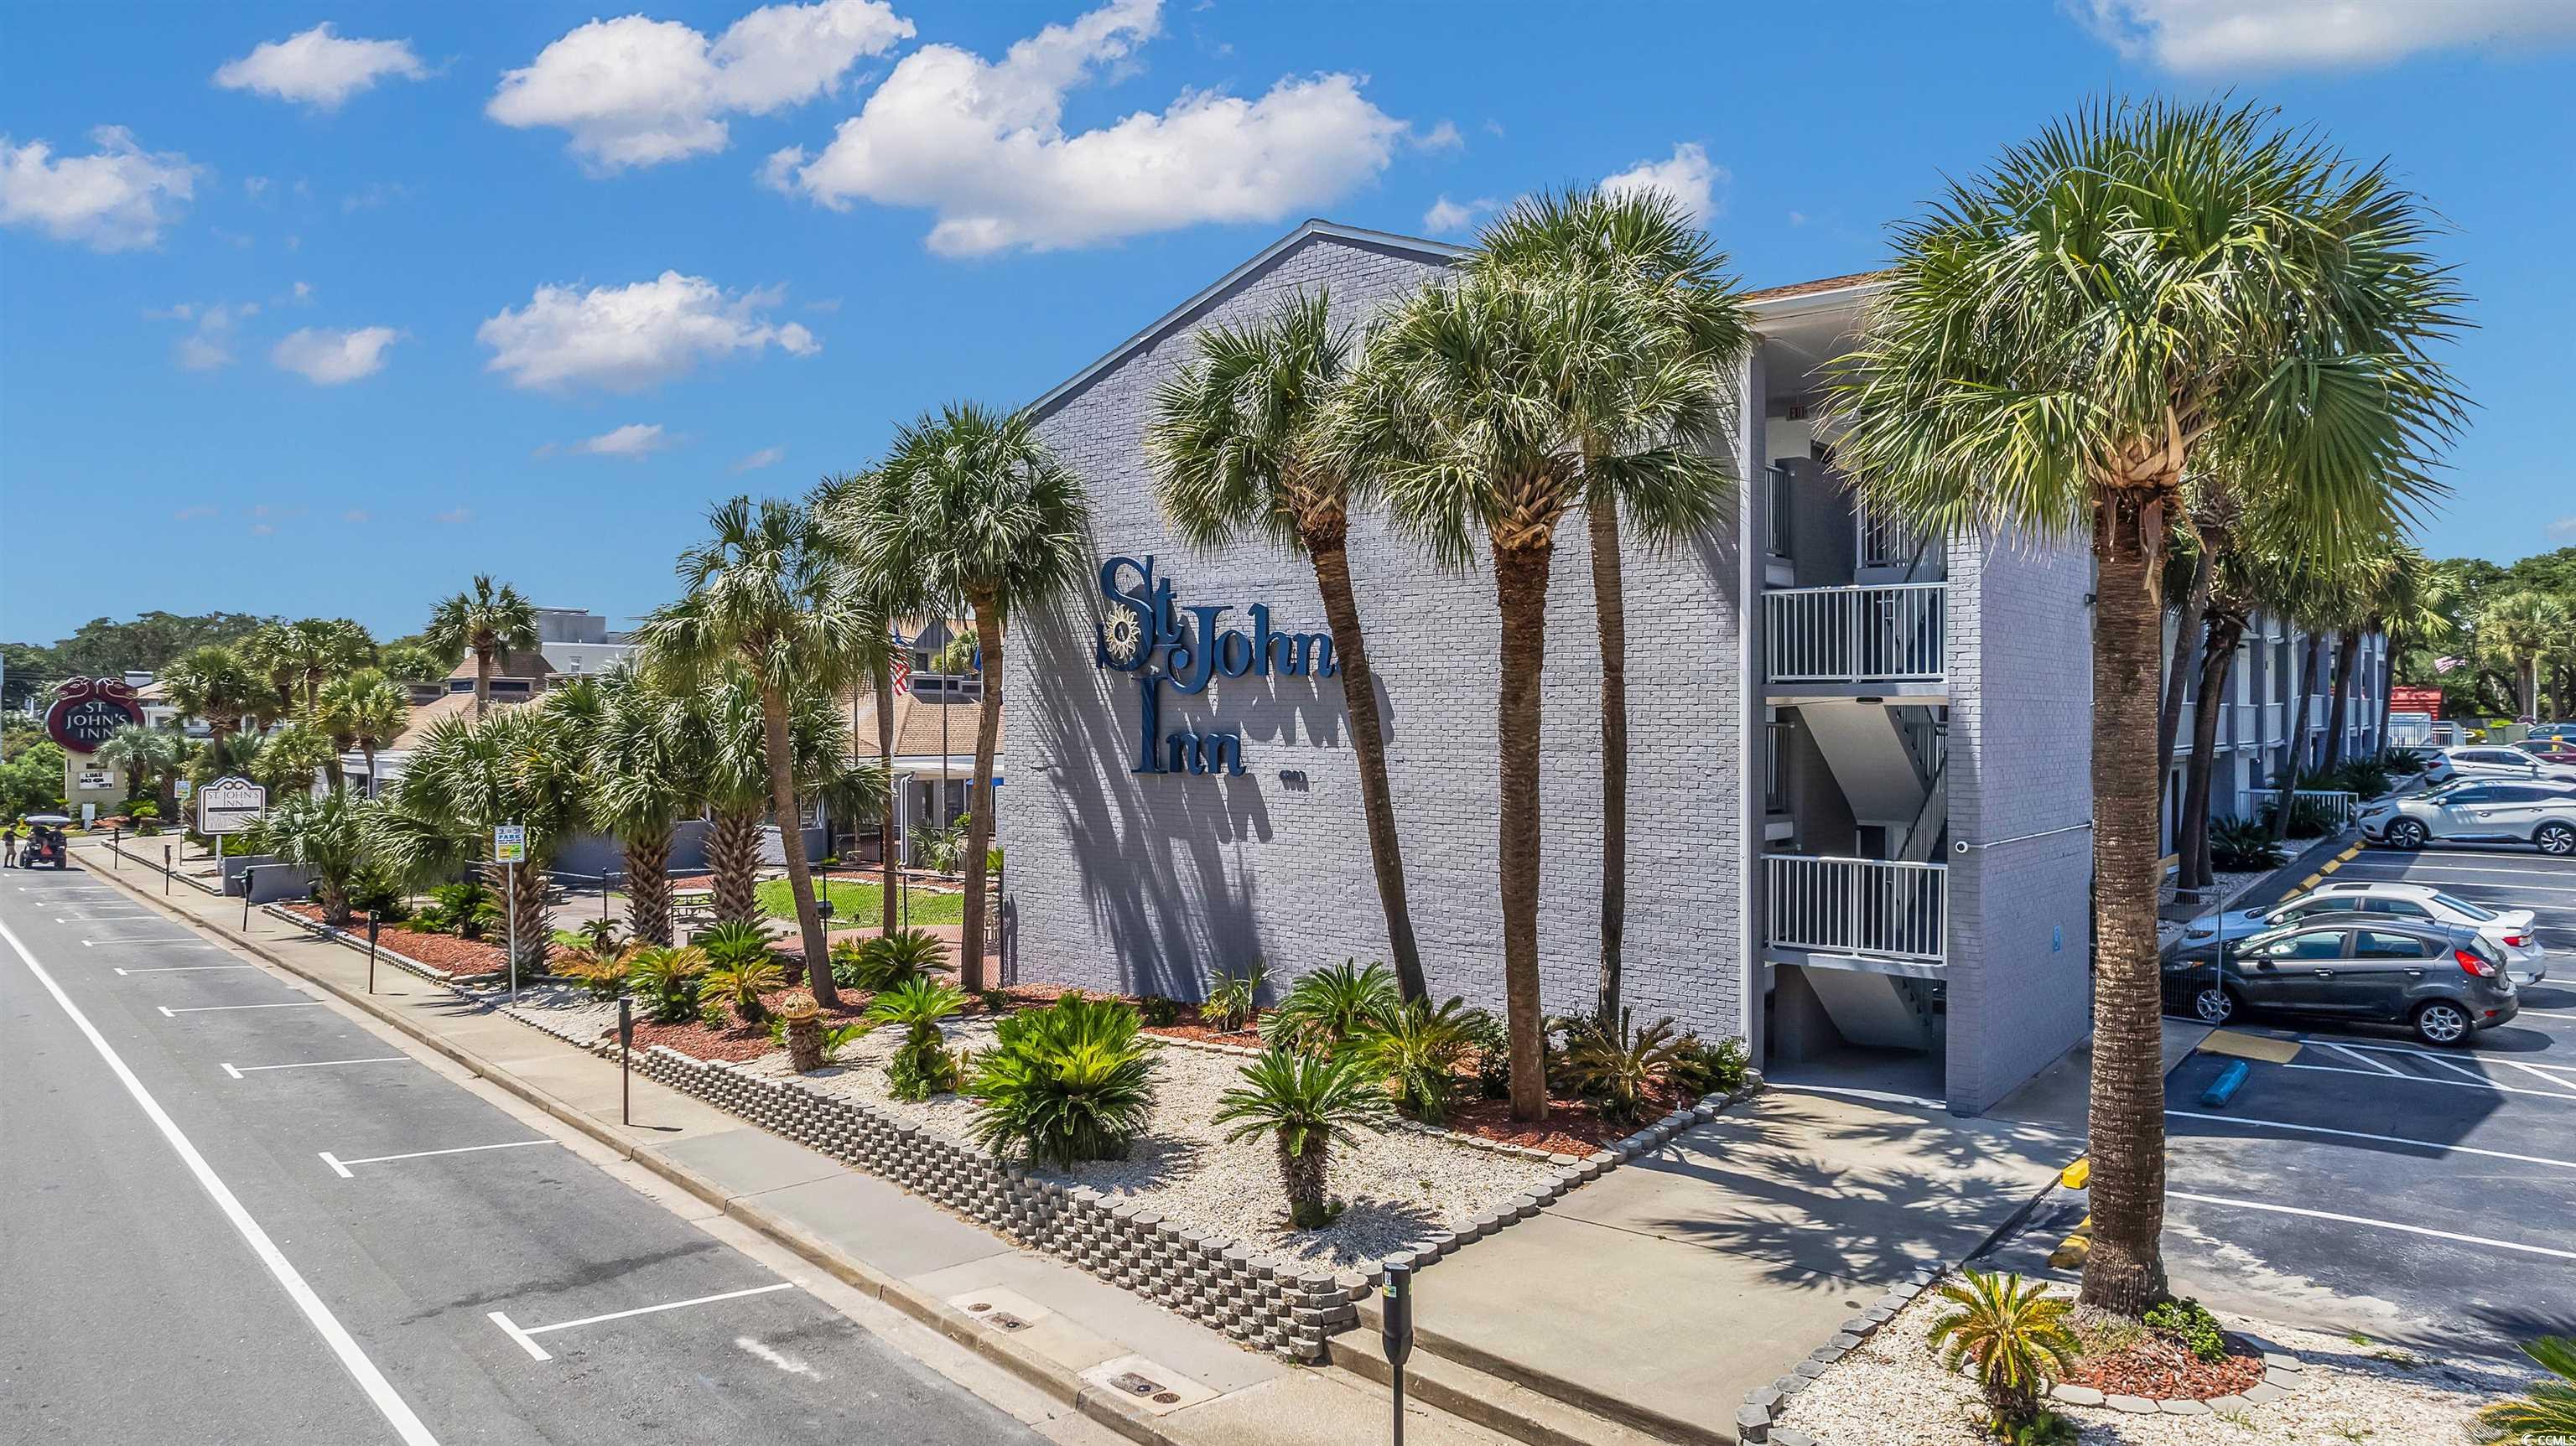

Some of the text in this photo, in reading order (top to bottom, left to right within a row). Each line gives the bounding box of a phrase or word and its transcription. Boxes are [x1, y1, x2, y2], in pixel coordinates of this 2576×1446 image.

[1096, 555, 1340, 695] St John
[86, 702, 106, 713] ST
[66, 713, 127, 729] JOHN'S
[1131, 676, 1247, 777] Inn
[80, 728, 114, 739] INN
[223, 791, 259, 800] JOHN'S
